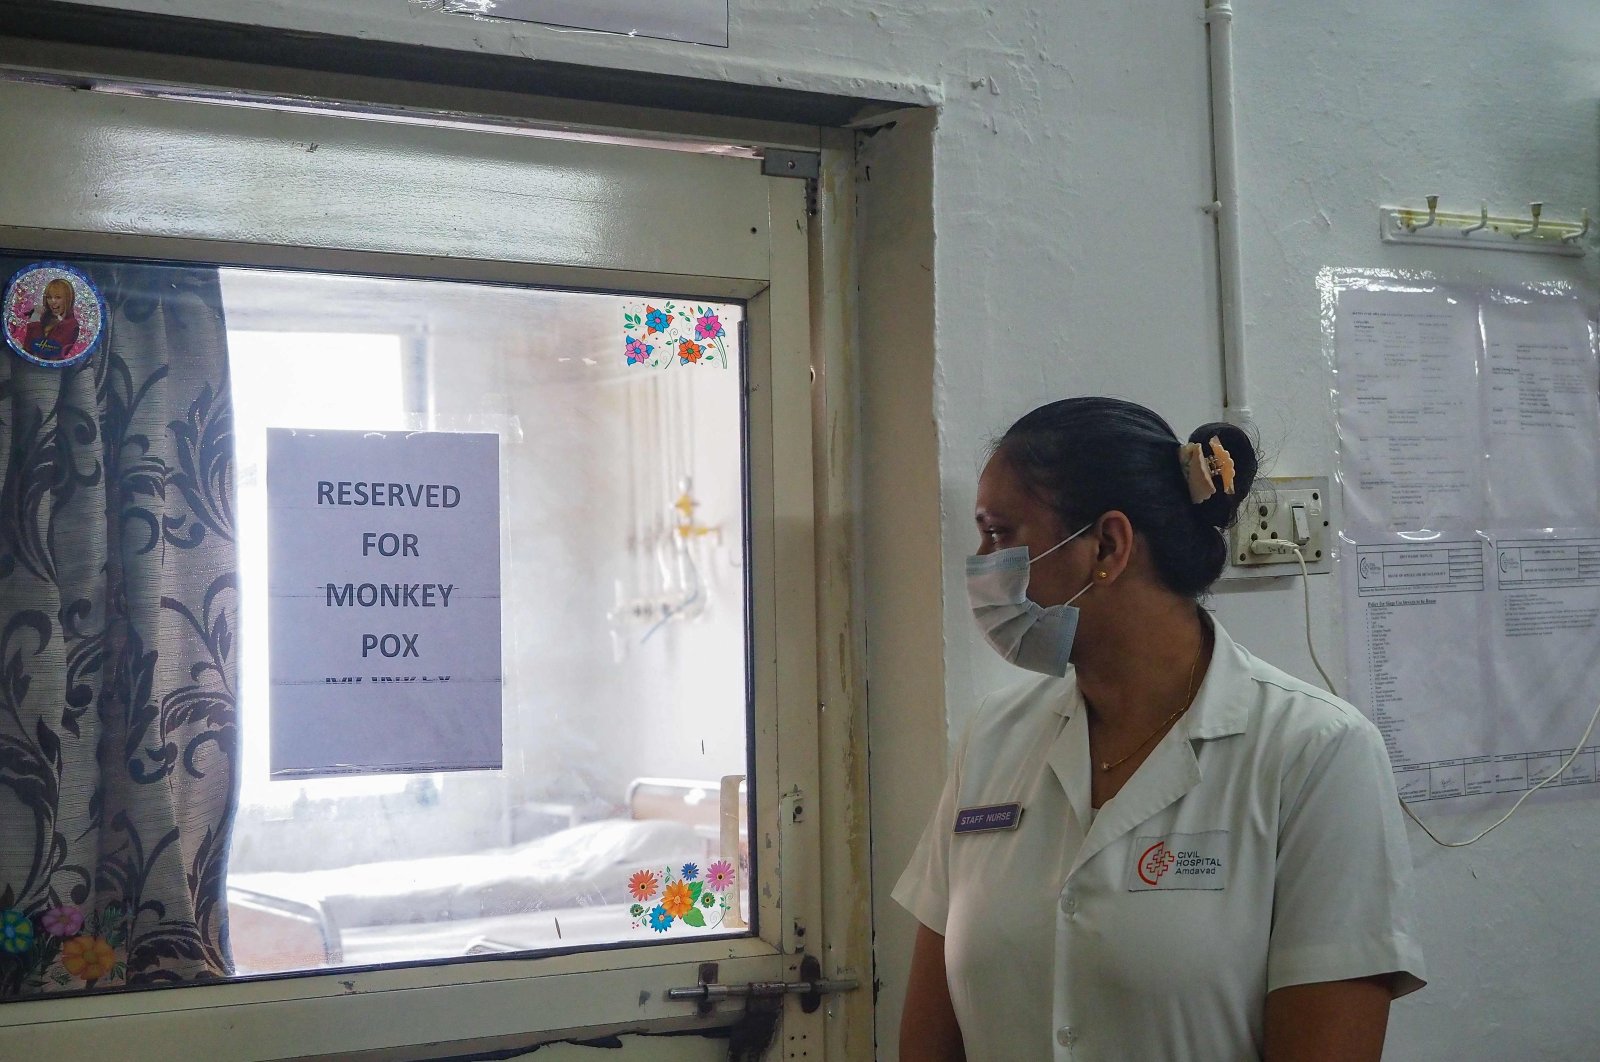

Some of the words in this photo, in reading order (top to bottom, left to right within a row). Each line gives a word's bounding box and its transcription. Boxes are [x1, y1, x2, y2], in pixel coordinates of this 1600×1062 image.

[317, 481, 461, 508] RESERVED
[362, 532, 420, 557] FOR
[326, 583, 454, 607] MONKEY
[362, 633, 420, 658] POX
[960, 815, 985, 826] STAFF
[986, 811, 1012, 823] NURSE
[1176, 858, 1222, 867] HOSPITAL
[1177, 851, 1200, 859] CIVIL
[1175, 866, 1216, 875] Amdavad
